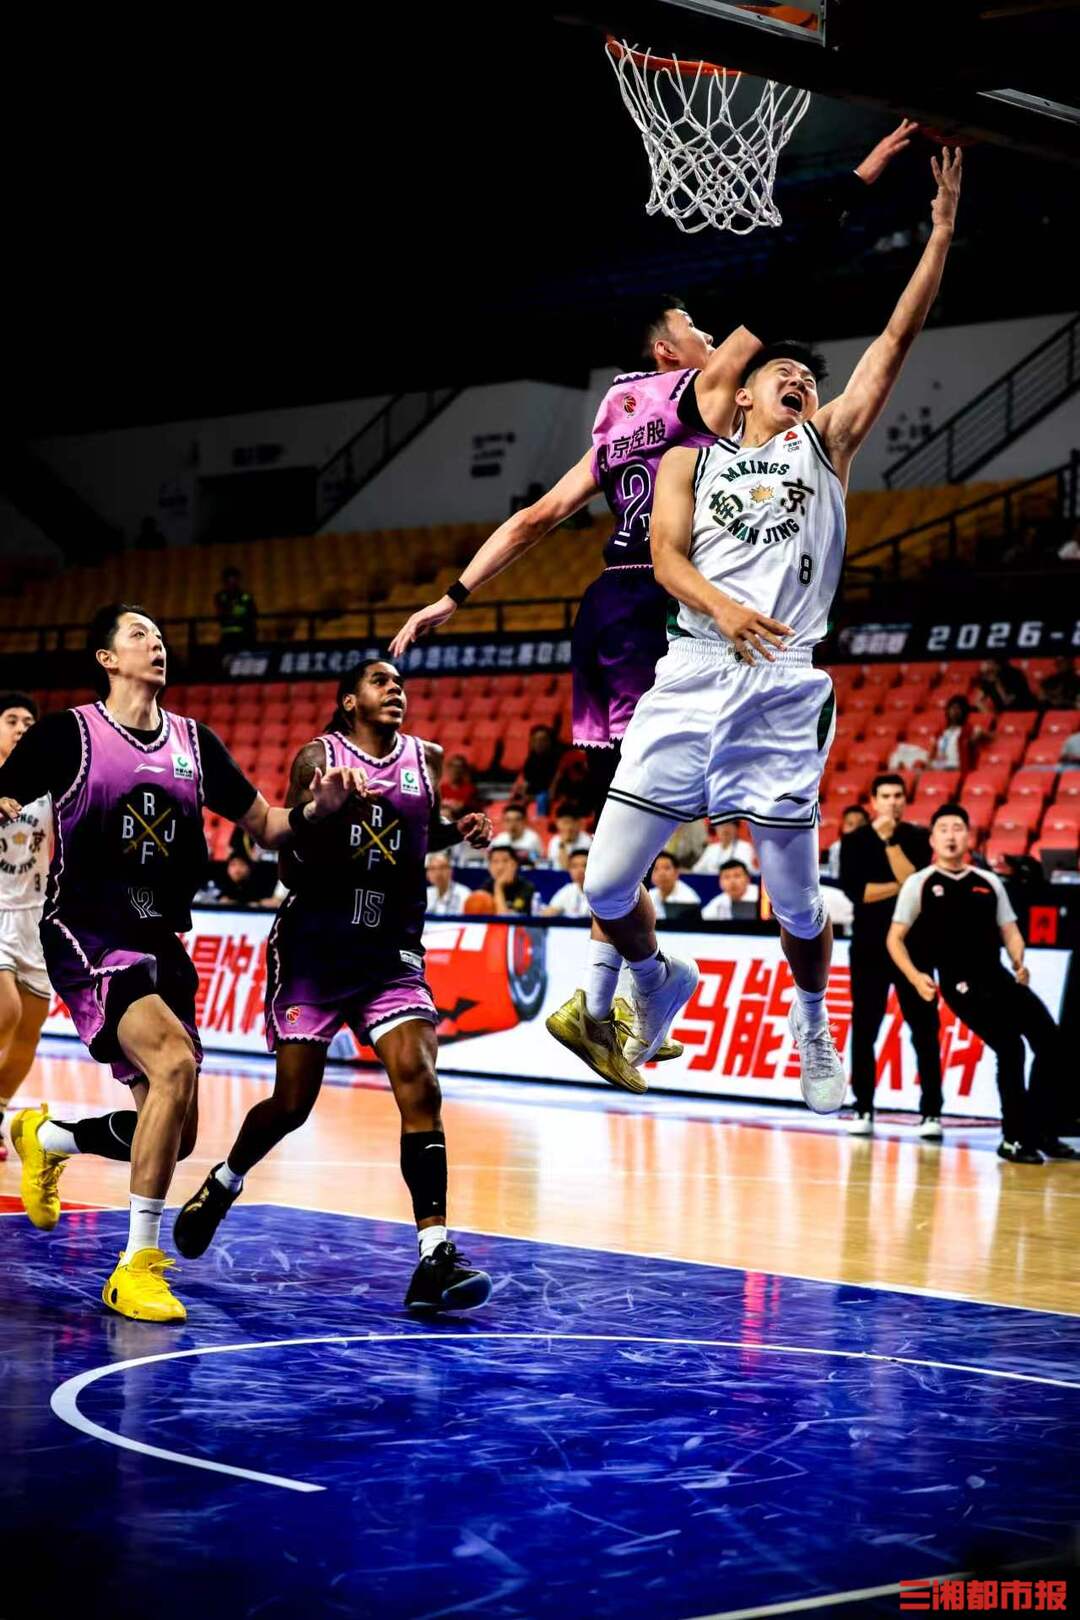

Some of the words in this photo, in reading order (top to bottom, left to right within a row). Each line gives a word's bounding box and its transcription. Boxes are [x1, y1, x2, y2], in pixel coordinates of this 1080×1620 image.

[607, 420, 666, 458] 京控股
[720, 460, 790, 482] MKINGS
[727, 518, 760, 545] NAN
[763, 518, 800, 544] JING
[799, 553, 813, 585] 8
[143, 792, 155, 816] R
[371, 805, 383, 828] R
[122, 815, 134, 839] B
[164, 819, 176, 843] J
[350, 824, 362, 847] B
[389, 829, 402, 851] J
[141, 841, 155, 864] F
[367, 849, 381, 870] F
[351, 888, 385, 928] 15
